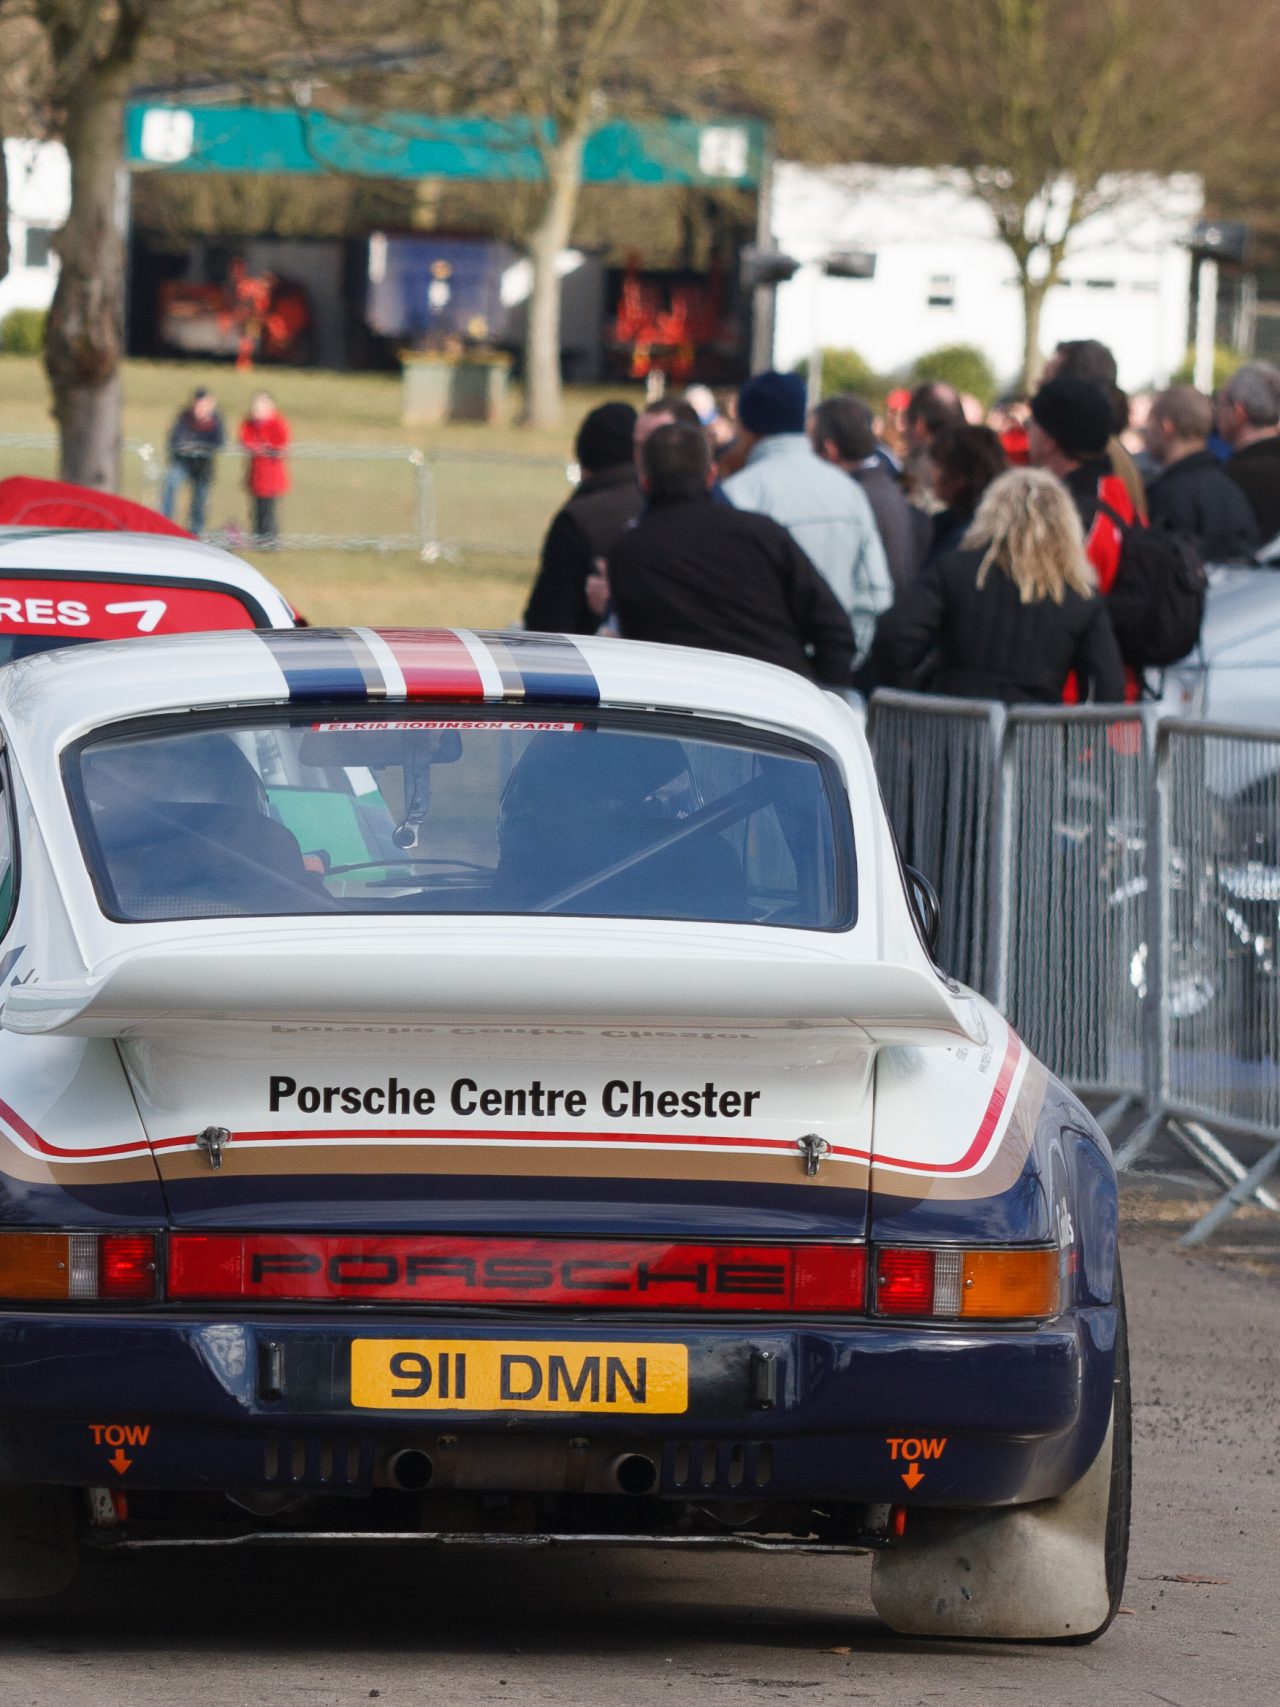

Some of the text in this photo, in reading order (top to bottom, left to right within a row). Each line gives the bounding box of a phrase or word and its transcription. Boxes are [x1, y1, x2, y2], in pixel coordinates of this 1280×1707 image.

[327, 721, 565, 731] ELKIN ROBINSON CARS
[268, 1075, 760, 1119] Porsche Centre Chester
[251, 1253, 784, 1295] PORSCHE
[389, 1351, 648, 1405] 911 DMN
[89, 1425, 150, 1446] TOW
[886, 1438, 947, 1460] TOW
